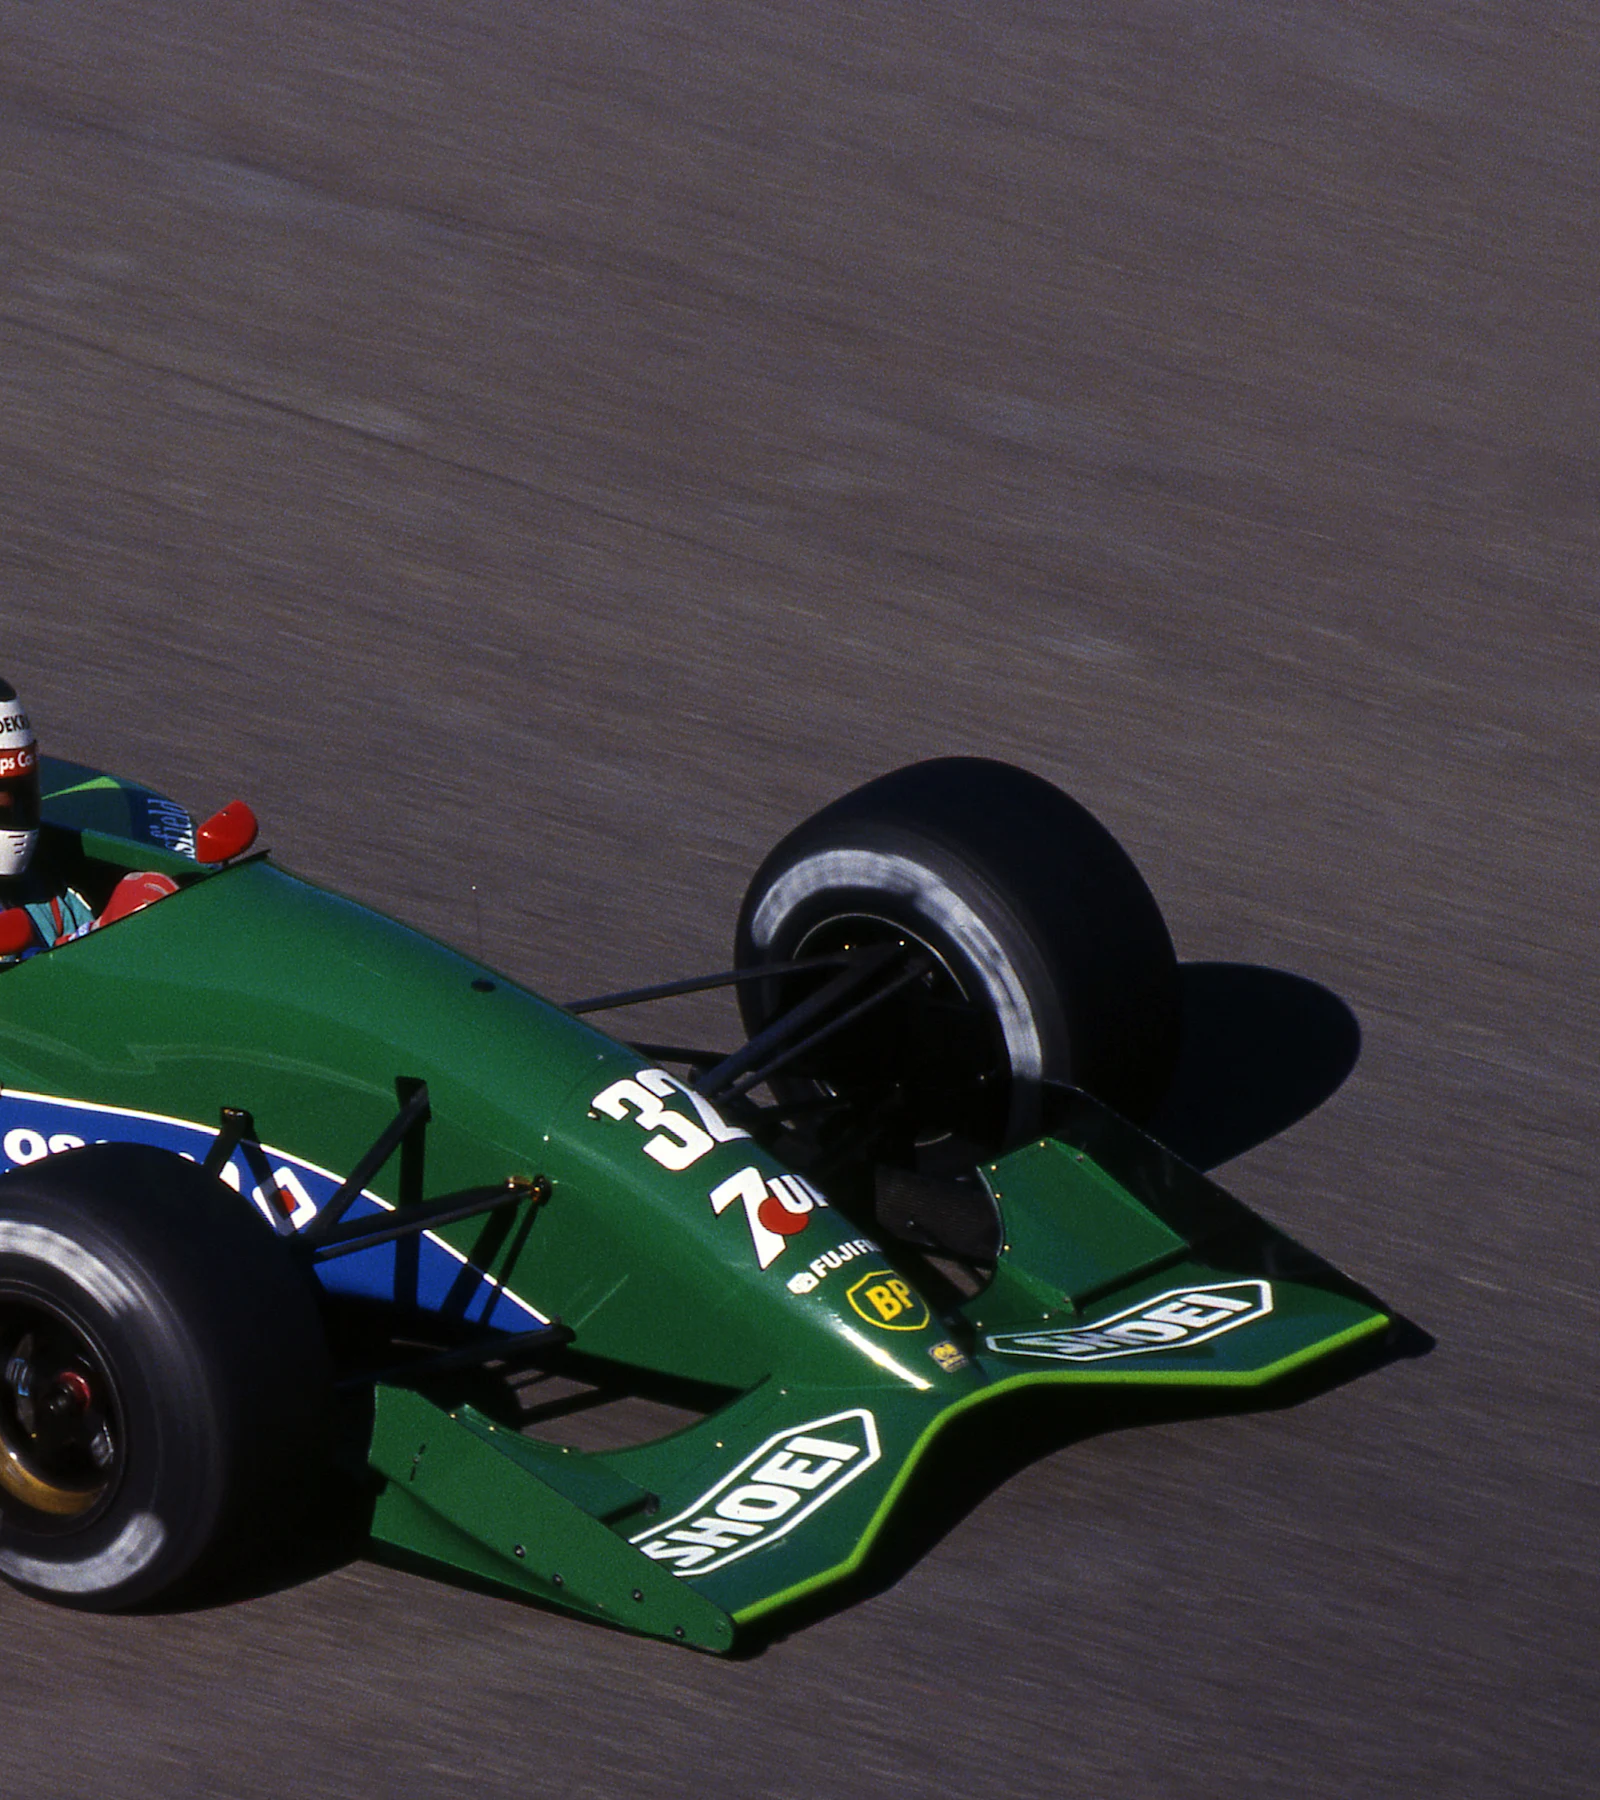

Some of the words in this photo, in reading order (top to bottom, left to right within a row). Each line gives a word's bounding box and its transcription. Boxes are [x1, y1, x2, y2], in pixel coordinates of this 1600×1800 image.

[591, 1068, 752, 1171] 32
[865, 1279, 914, 1322] BP
[1012, 1293, 1252, 1354] SHOEI
[640, 1436, 860, 1568] SHOEI
